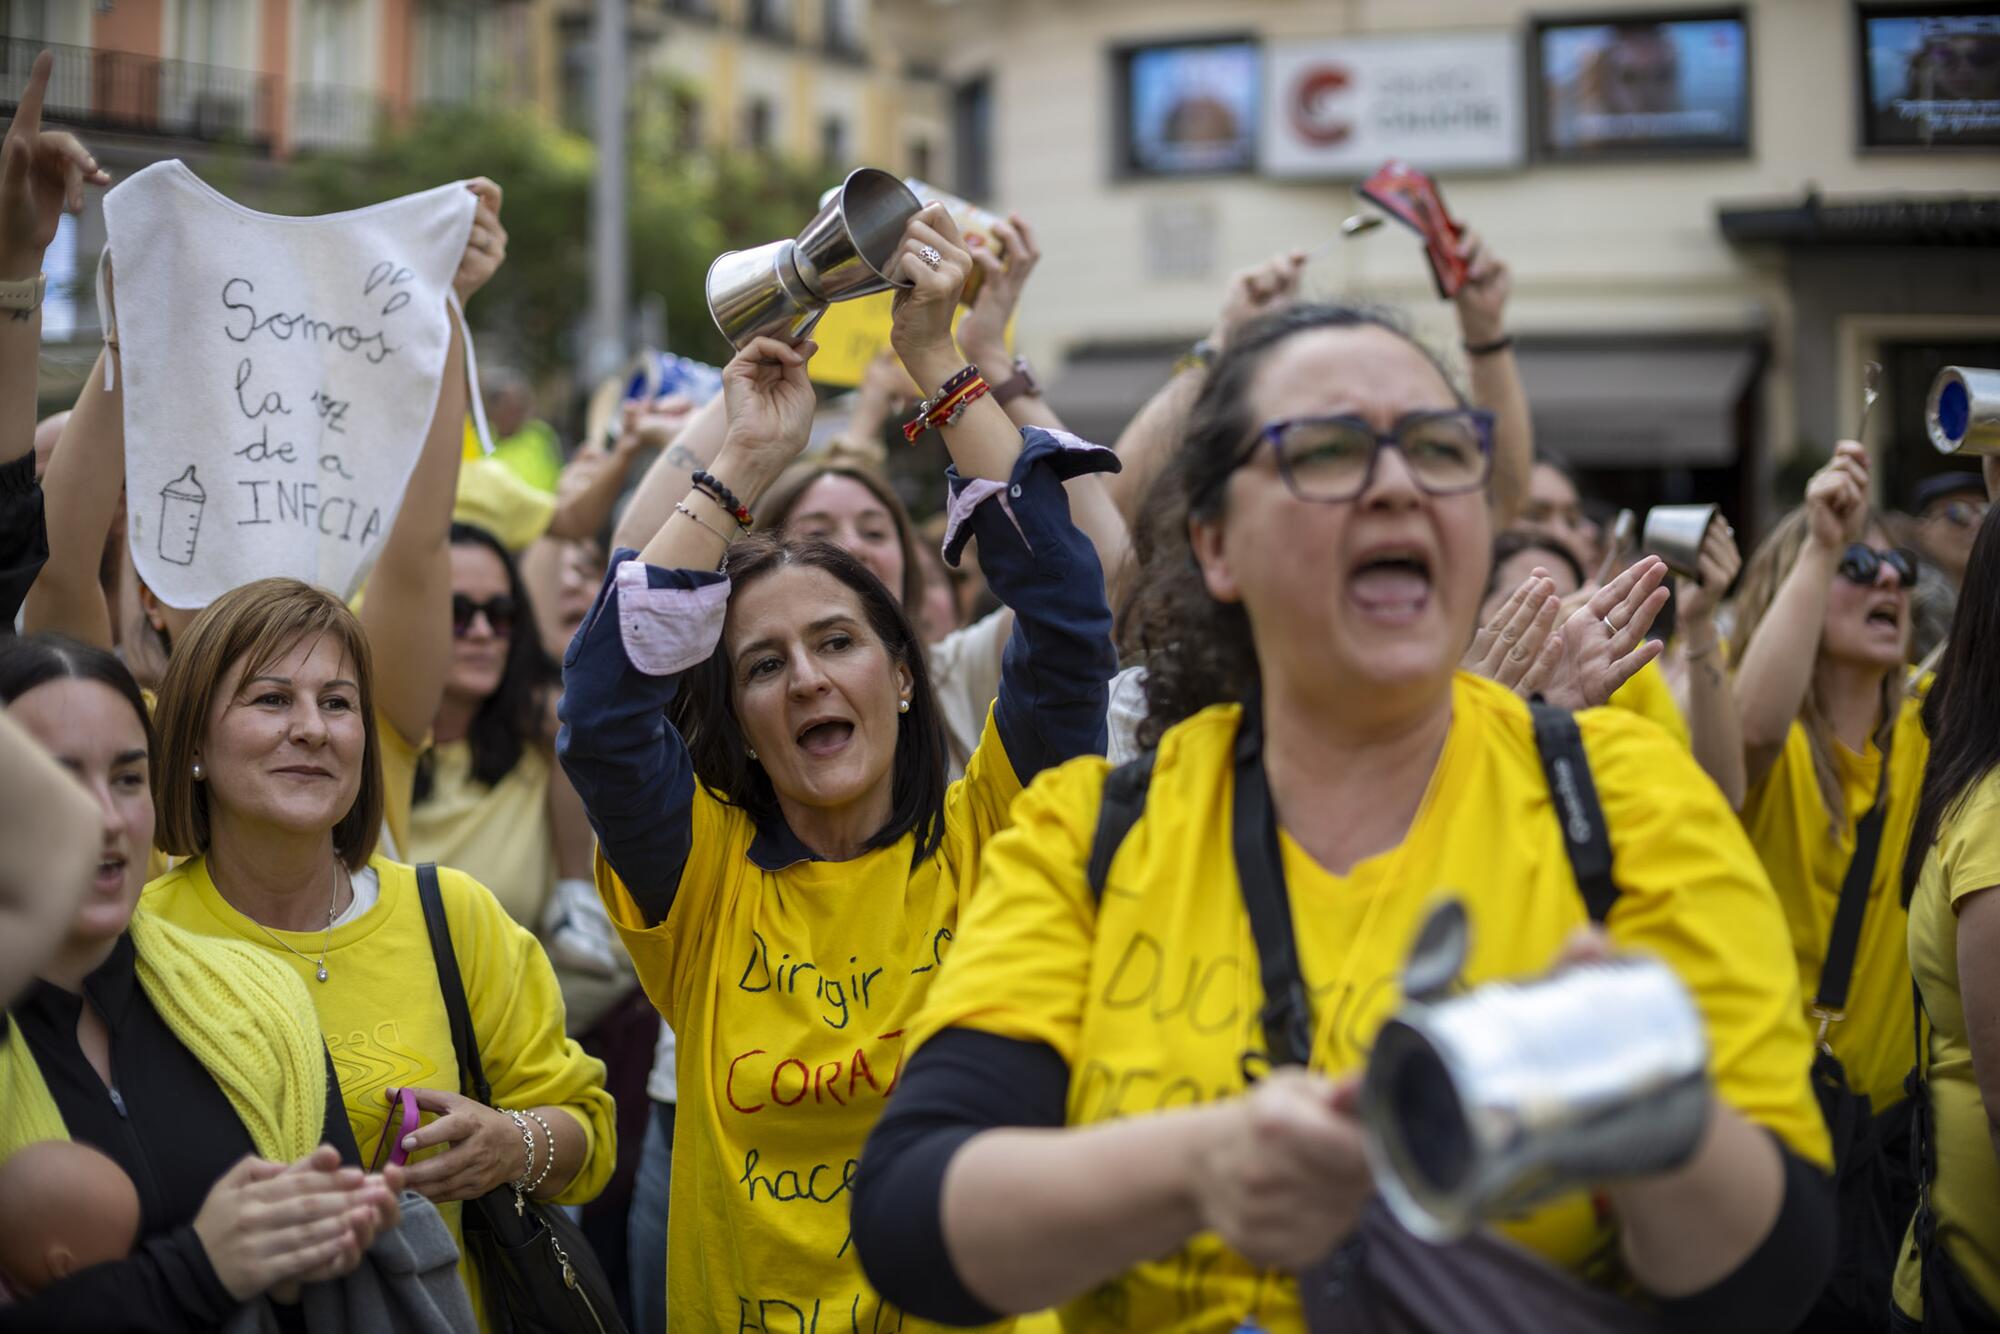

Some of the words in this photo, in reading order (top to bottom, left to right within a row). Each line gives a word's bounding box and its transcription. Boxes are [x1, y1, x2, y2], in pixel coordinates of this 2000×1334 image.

[222, 277, 400, 364] Somos
[235, 357, 291, 419] la
[234, 424, 298, 463] de
[738, 929, 883, 1029] Dirigir
